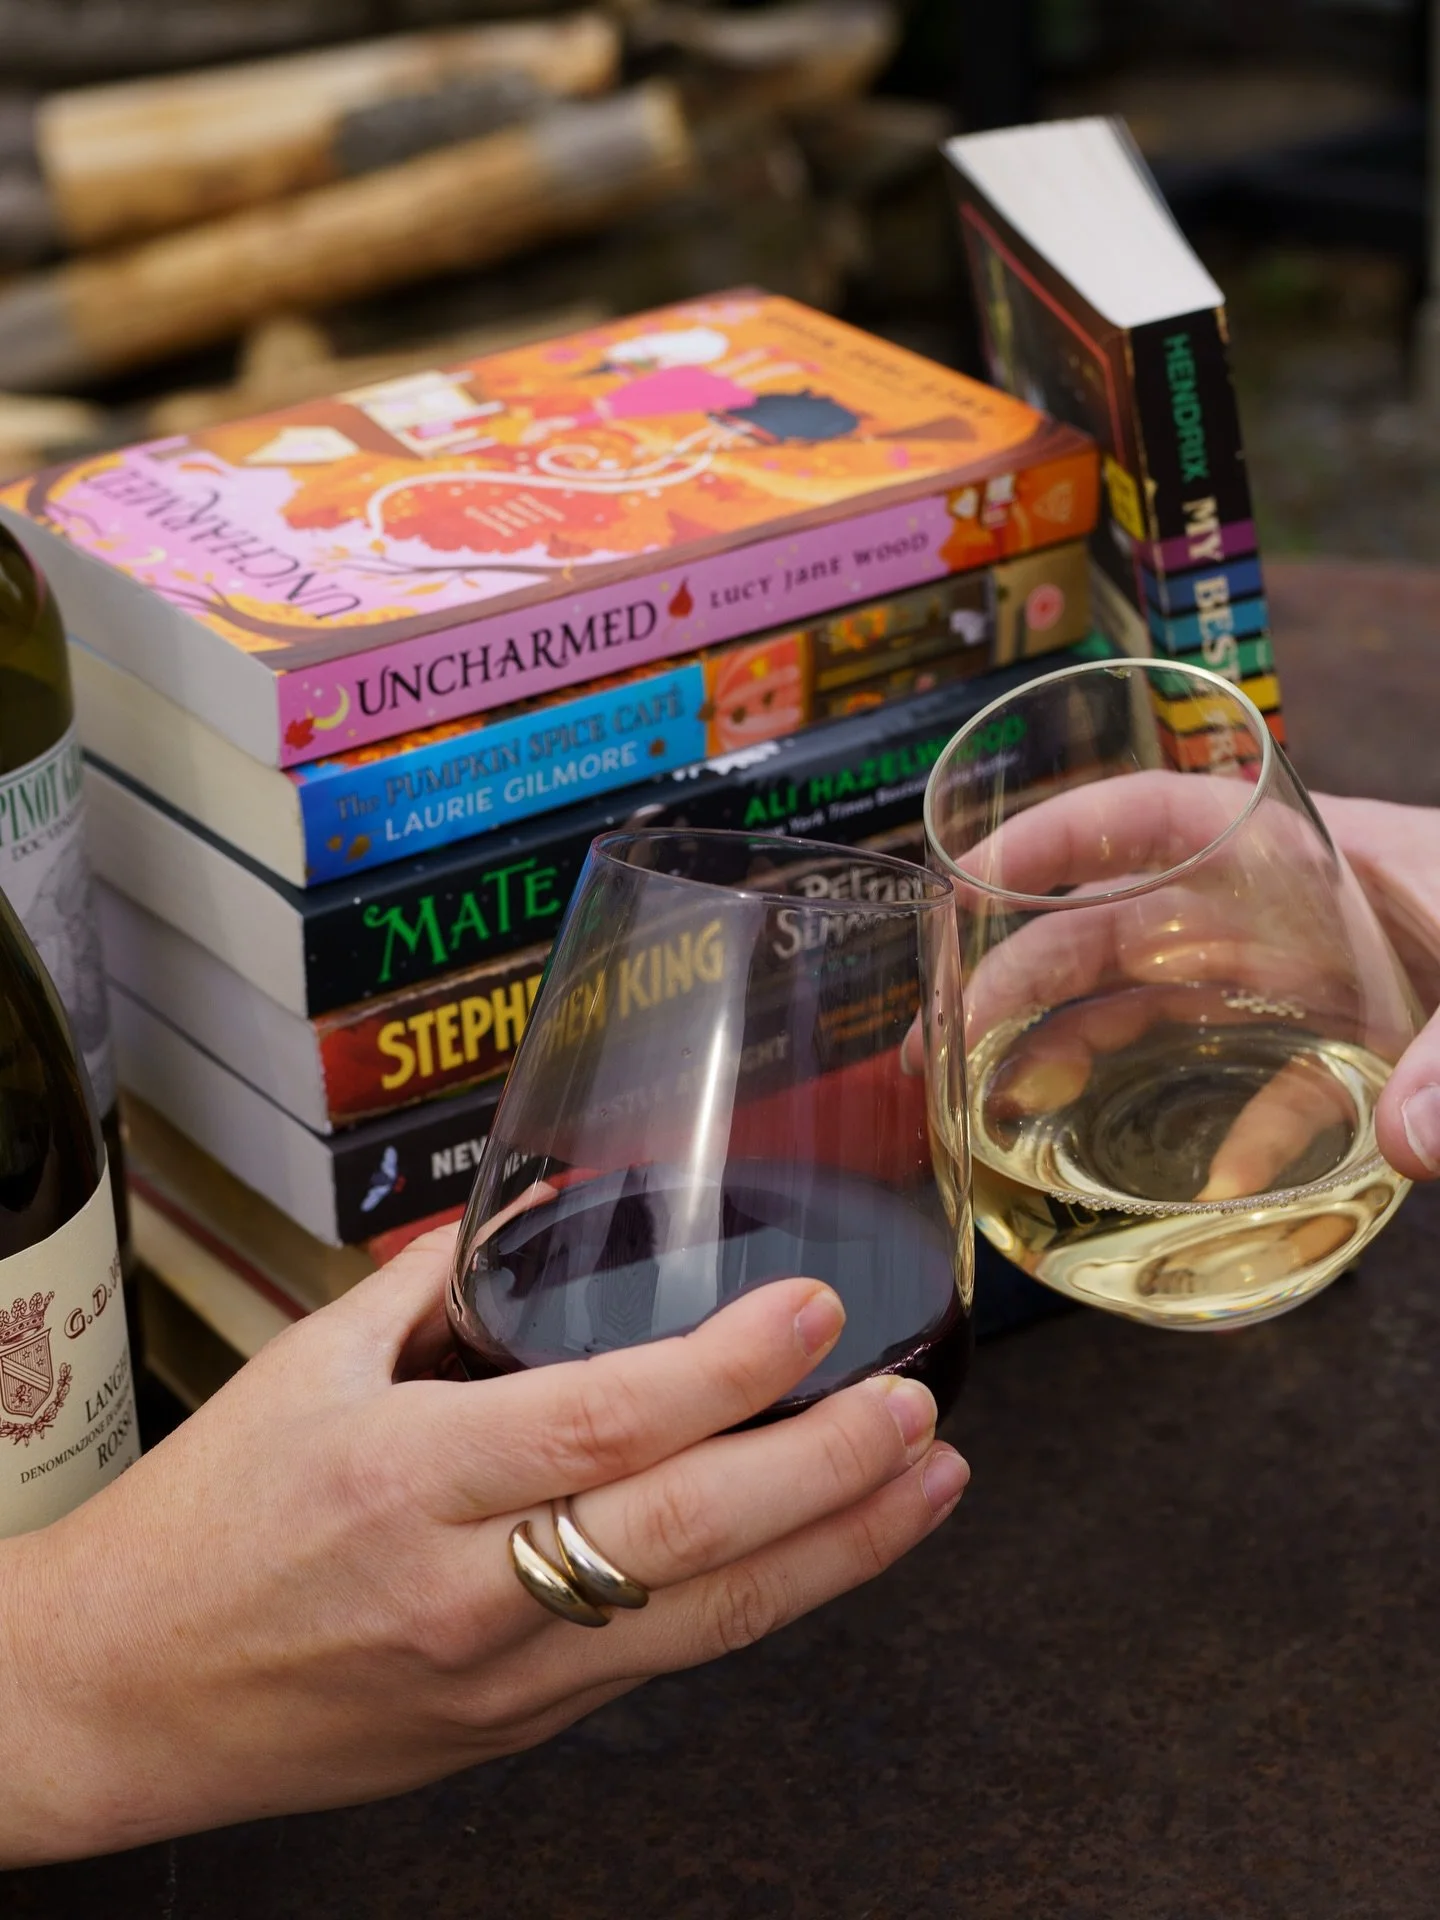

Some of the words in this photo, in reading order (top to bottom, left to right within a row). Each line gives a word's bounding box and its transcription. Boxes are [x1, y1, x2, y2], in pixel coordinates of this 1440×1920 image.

[1163, 333, 1209, 483] HENDRIX
[709, 578, 772, 610] LUCY
[853, 531, 930, 567] WOOD
[1182, 496, 1225, 561] MY
[355, 600, 657, 716] UNCHARMED
[1194, 576, 1241, 684] BEST
[384, 787, 494, 841] LAURIE
[503, 741, 638, 805] GILMORE
[386, 738, 521, 806] PUMPKIN
[528, 708, 608, 763] SPICE
[744, 784, 797, 826] ALI
[363, 857, 560, 983] MATE
[618, 916, 726, 1019] KING
